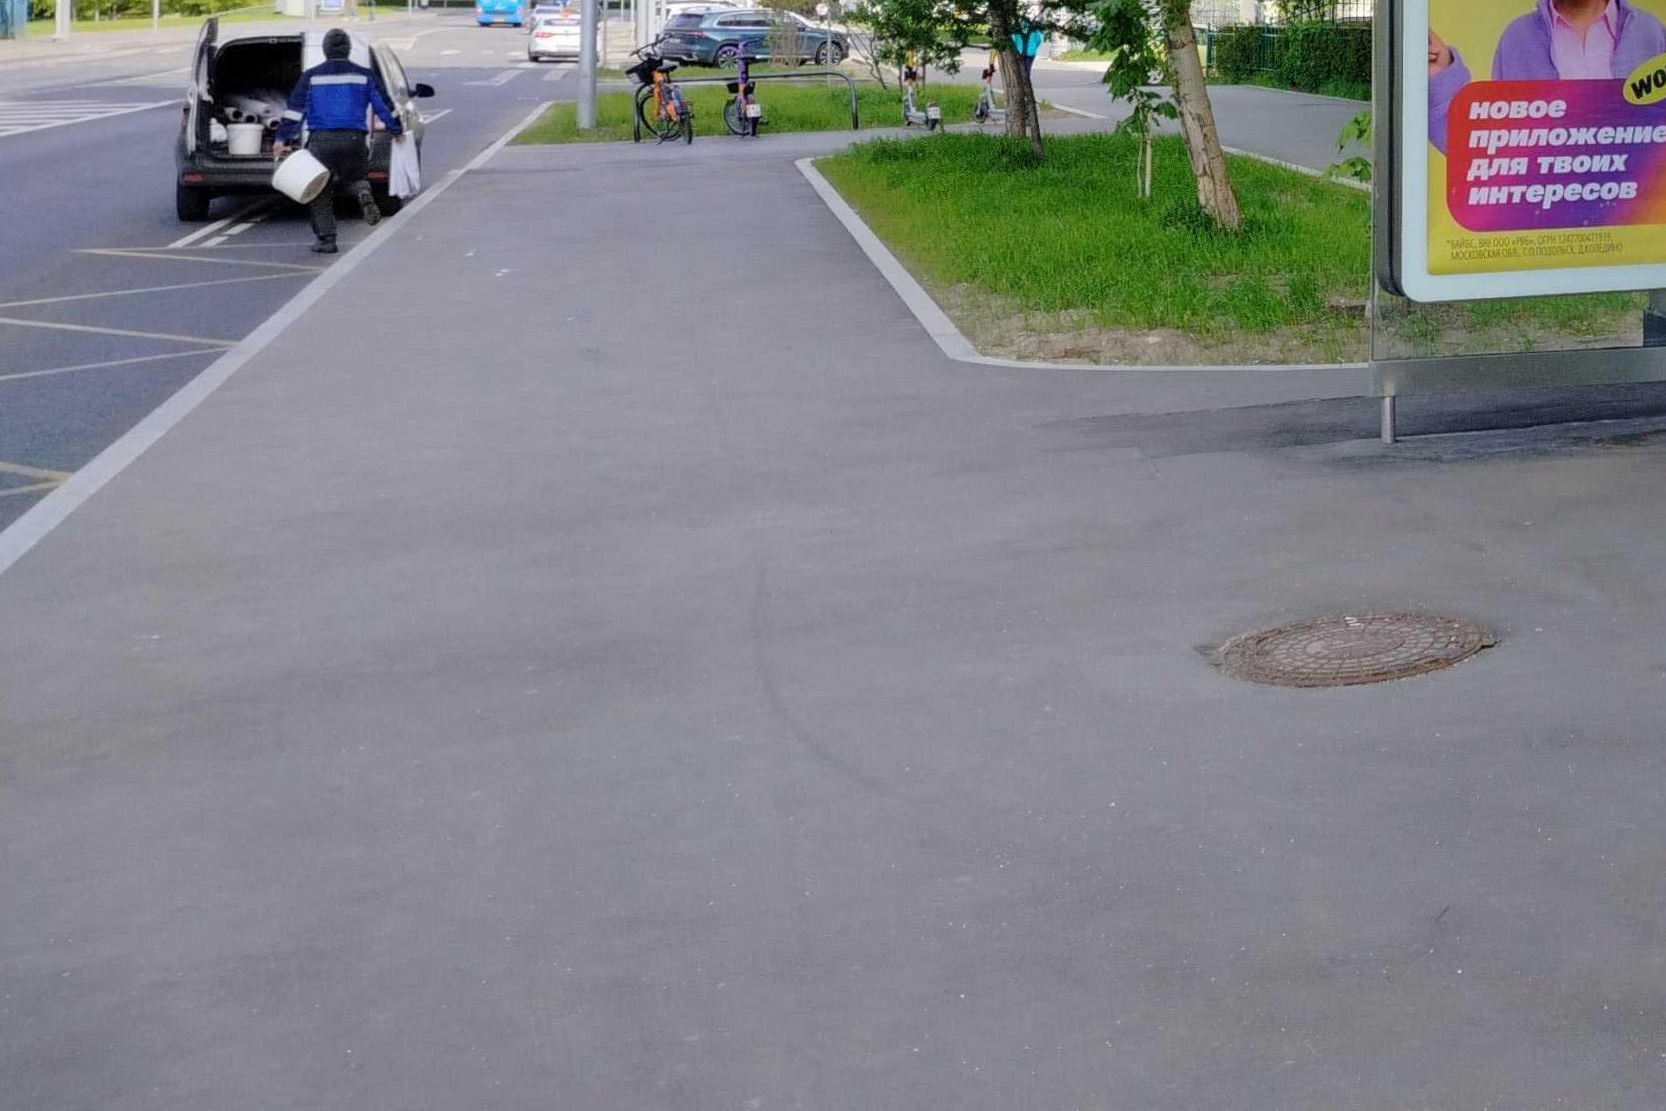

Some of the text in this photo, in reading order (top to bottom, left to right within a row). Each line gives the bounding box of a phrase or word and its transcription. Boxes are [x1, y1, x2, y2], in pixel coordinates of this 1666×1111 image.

[1468, 99, 1567, 120] новое
[1466, 154, 1629, 181] для твоих
[1467, 181, 1638, 210] интересов
